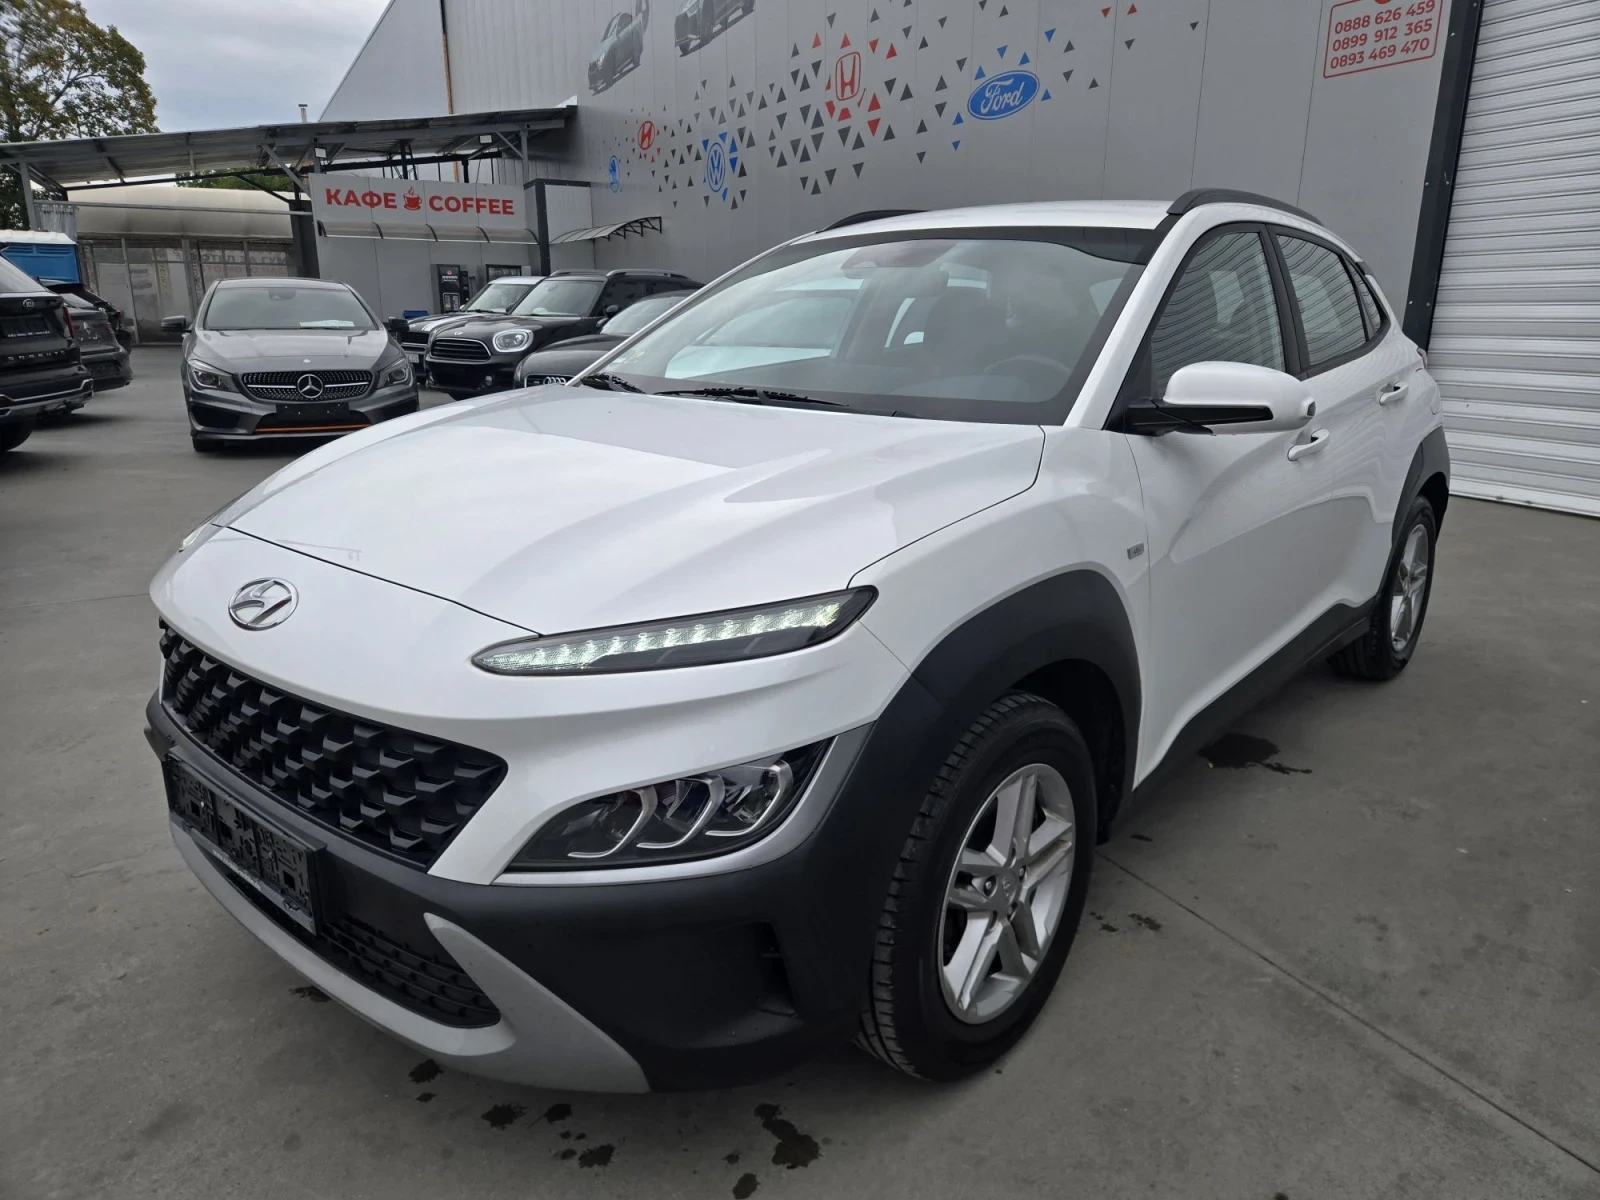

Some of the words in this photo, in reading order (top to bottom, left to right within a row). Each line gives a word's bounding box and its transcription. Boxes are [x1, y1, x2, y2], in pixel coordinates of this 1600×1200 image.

[1335, 15, 1371, 34] 0888
[1375, 7, 1402, 25] 626
[1406, 0, 1436, 17] 459
[1332, 33, 1368, 52] 0899
[1374, 26, 1398, 43] 912
[1404, 18, 1433, 36] 365
[1330, 51, 1365, 69] 0893
[1368, 44, 1397, 60] 469
[1400, 37, 1430, 55] 470
[980, 78, 1025, 114] Ford
[325, 188, 398, 209] КАФЕ
[428, 195, 515, 215] COFFEE
